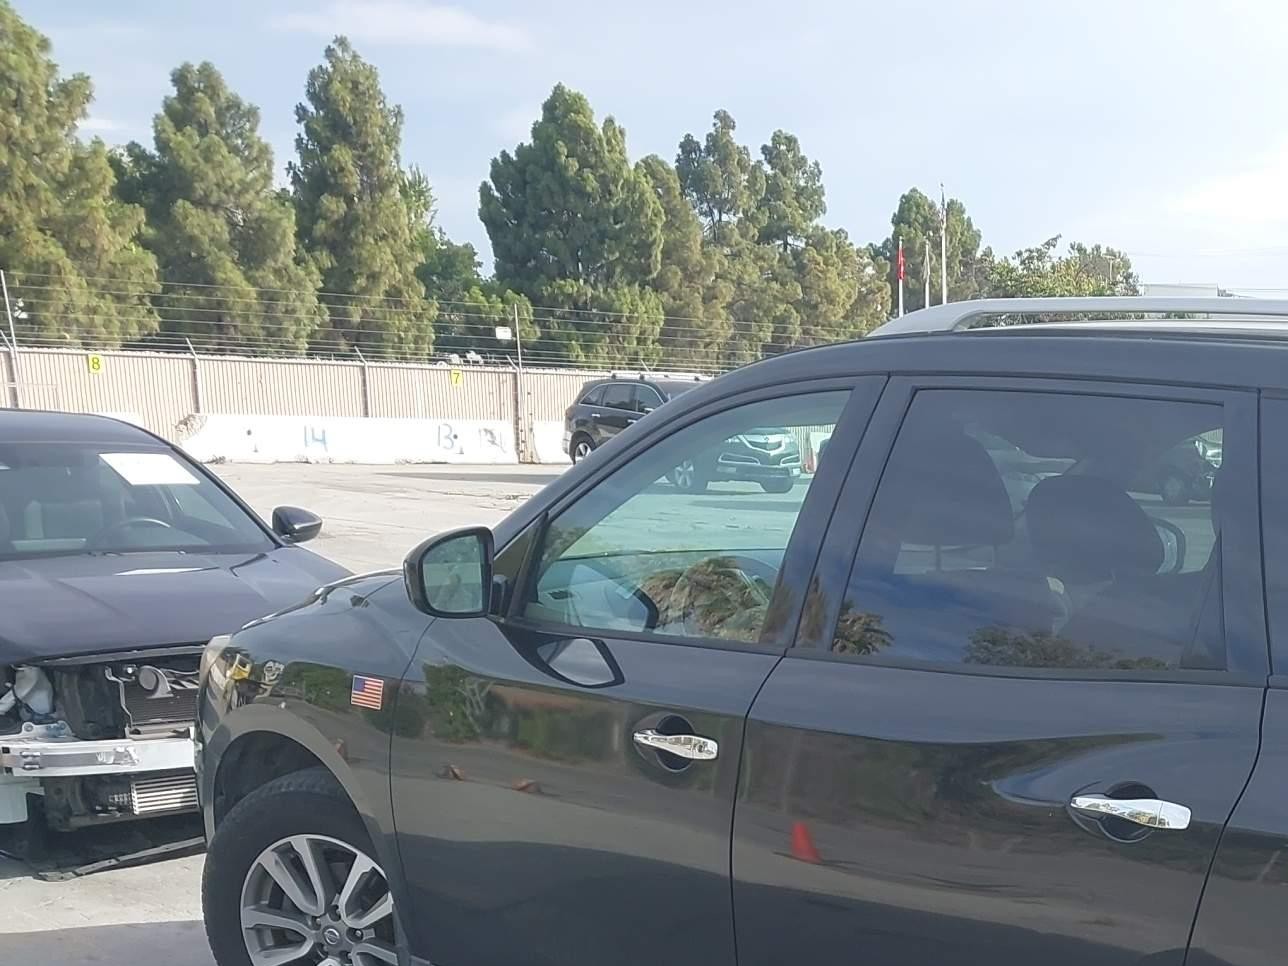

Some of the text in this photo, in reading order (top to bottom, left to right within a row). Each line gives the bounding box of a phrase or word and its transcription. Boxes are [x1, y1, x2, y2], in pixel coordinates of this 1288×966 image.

[91, 356, 101, 371] 8
[452, 372, 461, 385] 7
[303, 424, 329, 453] 14
